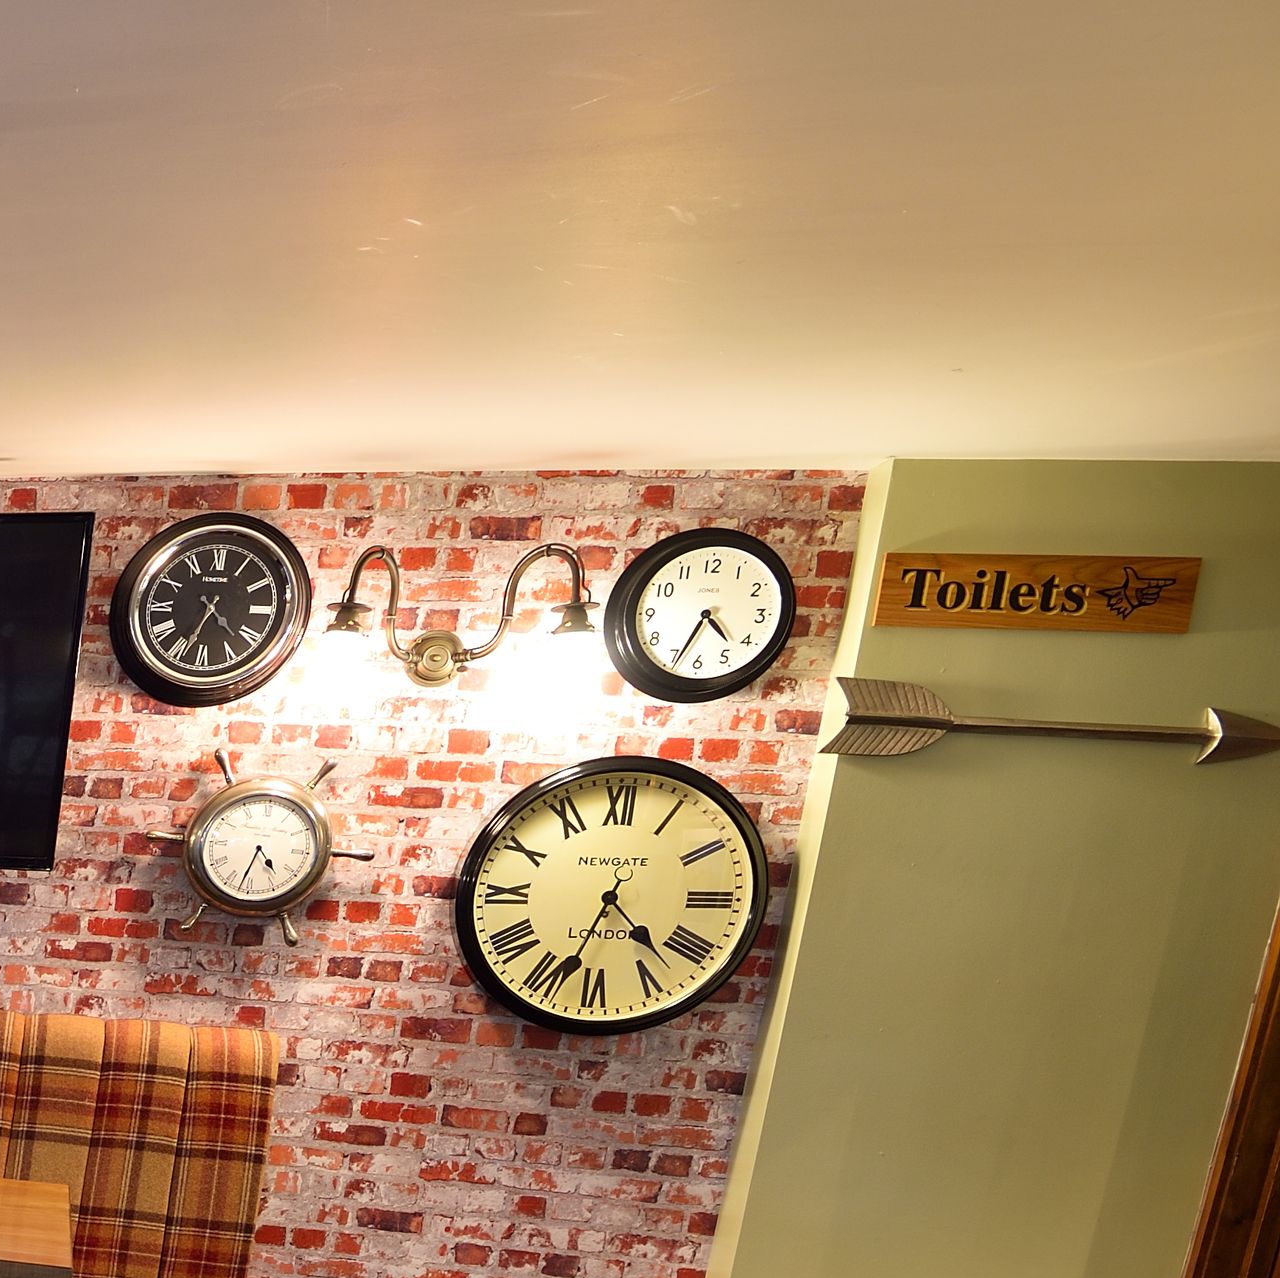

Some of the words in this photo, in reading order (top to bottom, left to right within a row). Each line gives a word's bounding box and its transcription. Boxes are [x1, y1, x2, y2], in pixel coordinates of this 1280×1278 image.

[185, 554, 202, 578] XI
[209, 549, 227, 571] XII
[704, 559, 722, 574] 12
[679, 566, 690, 580] 11
[736, 565, 741, 580] 1
[657, 583, 674, 597] 10
[750, 583, 762, 597] 2
[901, 568, 1089, 616] Toilets
[645, 608, 655, 622] 9
[754, 609, 766, 624] 3
[649, 631, 660, 646] 8
[740, 634, 752, 647] 4
[670, 650, 679, 663] 7
[693, 655, 703, 669] 6
[719, 650, 730, 664] 5
[602, 785, 637, 827] XII
[549, 796, 587, 839] XI
[503, 835, 547, 868] X
[680, 839, 726, 867] II
[578, 856, 649, 867] NEWGATE
[484, 883, 532, 905] IX
[685, 891, 733, 908] III
[568, 927, 635, 940] LONDO
[490, 918, 541, 965] VIII
[662, 923, 718, 965] IIII
[635, 960, 664, 999] V
[580, 967, 606, 1008] VI
